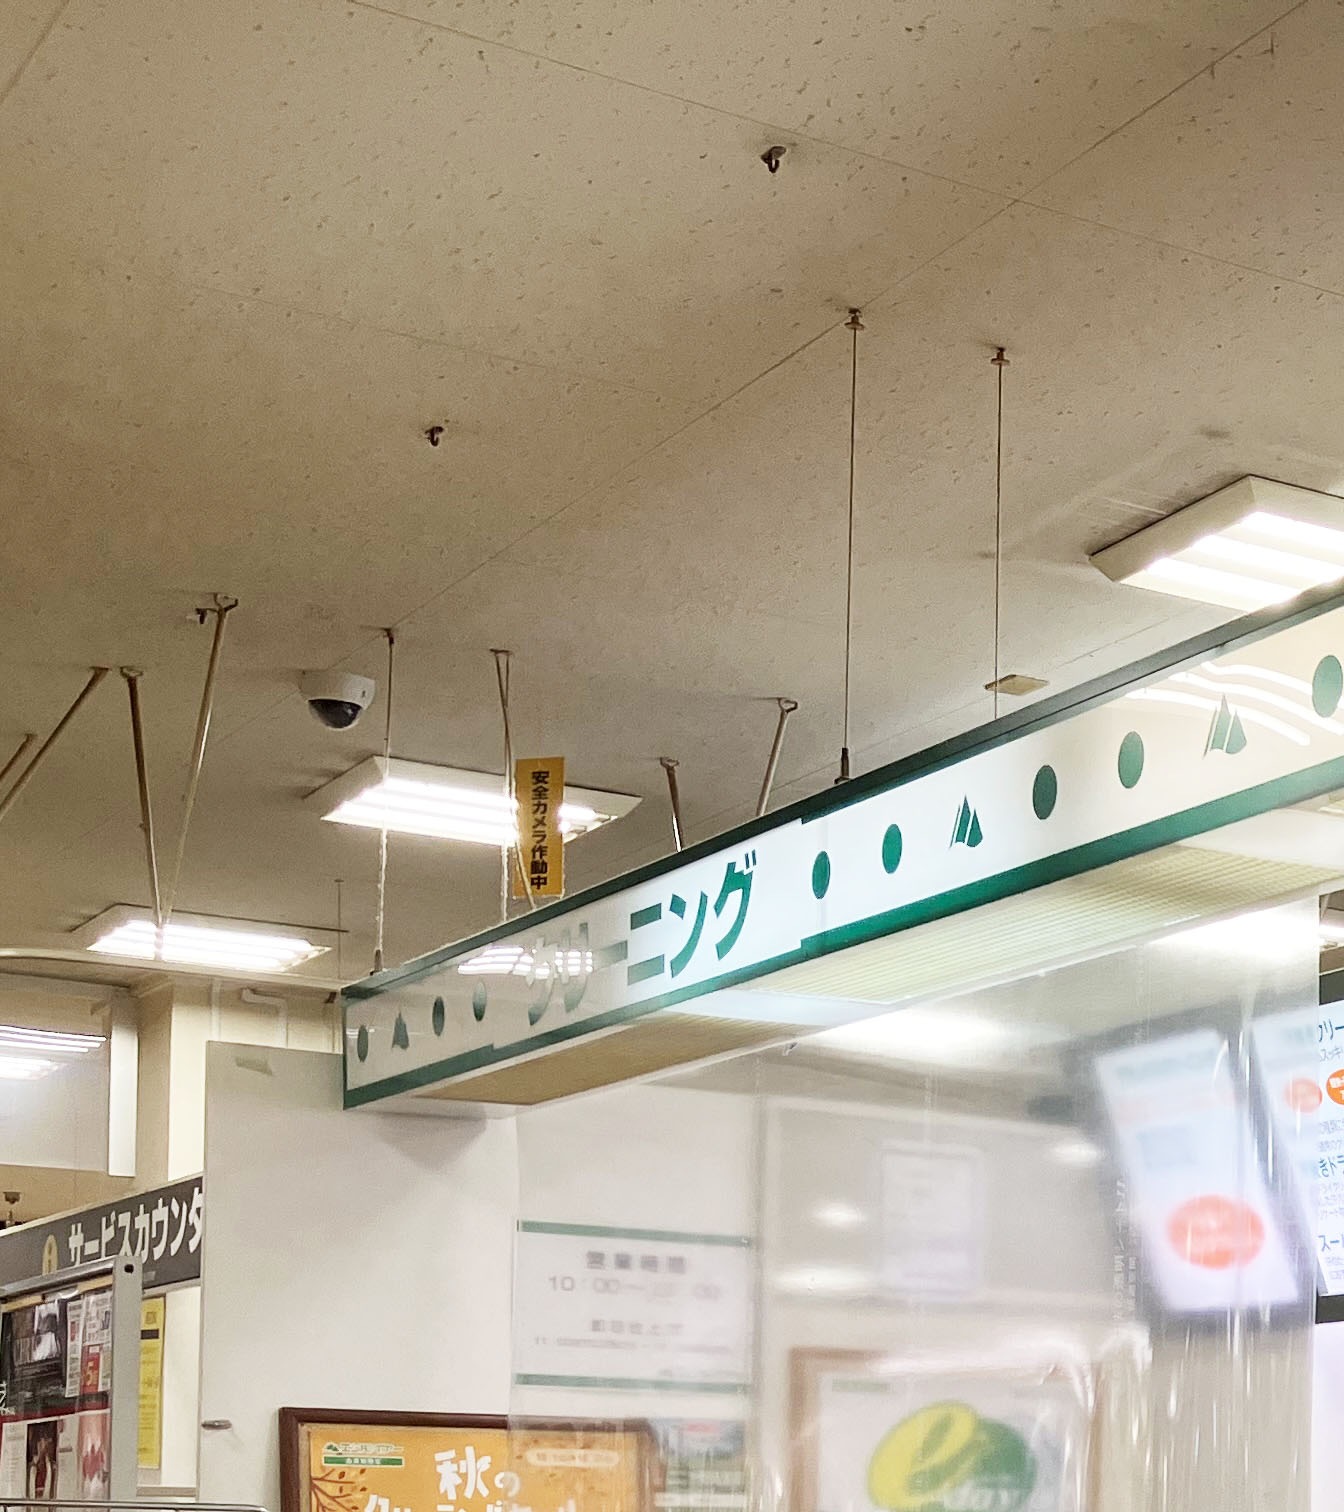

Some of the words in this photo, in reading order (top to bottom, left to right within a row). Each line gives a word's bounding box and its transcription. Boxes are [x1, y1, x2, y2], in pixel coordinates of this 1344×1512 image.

[529, 769, 550, 891] 安全カメラ作動中
[434, 1446, 521, 1500] 秋の
